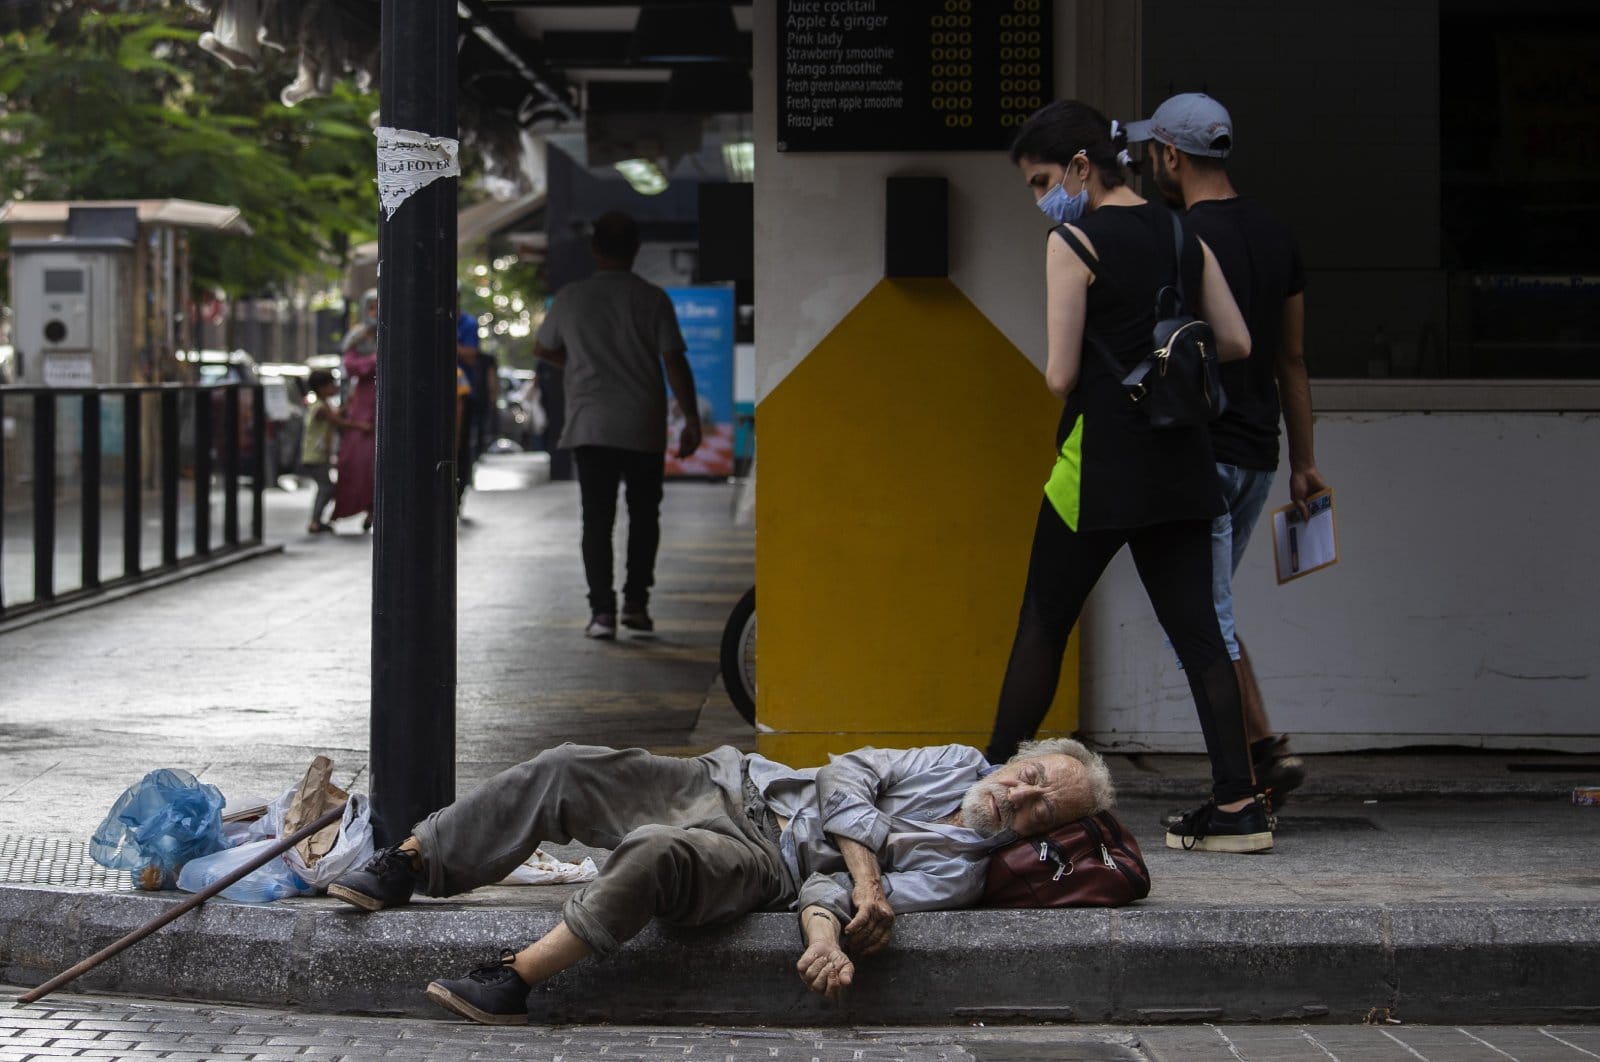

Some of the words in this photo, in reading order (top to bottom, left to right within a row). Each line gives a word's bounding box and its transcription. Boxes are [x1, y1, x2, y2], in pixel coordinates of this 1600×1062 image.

[787, 0, 821, 12] Juice
[824, 0, 876, 12] cocktail
[786, 14, 826, 30] Apple
[830, 14, 840, 27] &
[844, 15, 888, 31] ginger
[787, 32, 814, 45] Pink
[817, 32, 843, 48] lady
[786, 47, 843, 62] Strawberry
[846, 46, 895, 59] smoothie
[787, 63, 827, 79] Mango
[830, 62, 883, 74] smoothie
[786, 78, 809, 92] Fresh
[810, 80, 833, 96] green
[834, 79, 865, 92] banana
[866, 78, 904, 91] smoothie
[787, 95, 811, 109] Fresh
[812, 97, 837, 112] green
[838, 96, 862, 112] apple
[863, 95, 904, 109] smoothie
[812, 114, 835, 132] juice
[407, 159, 450, 171] FOYER
